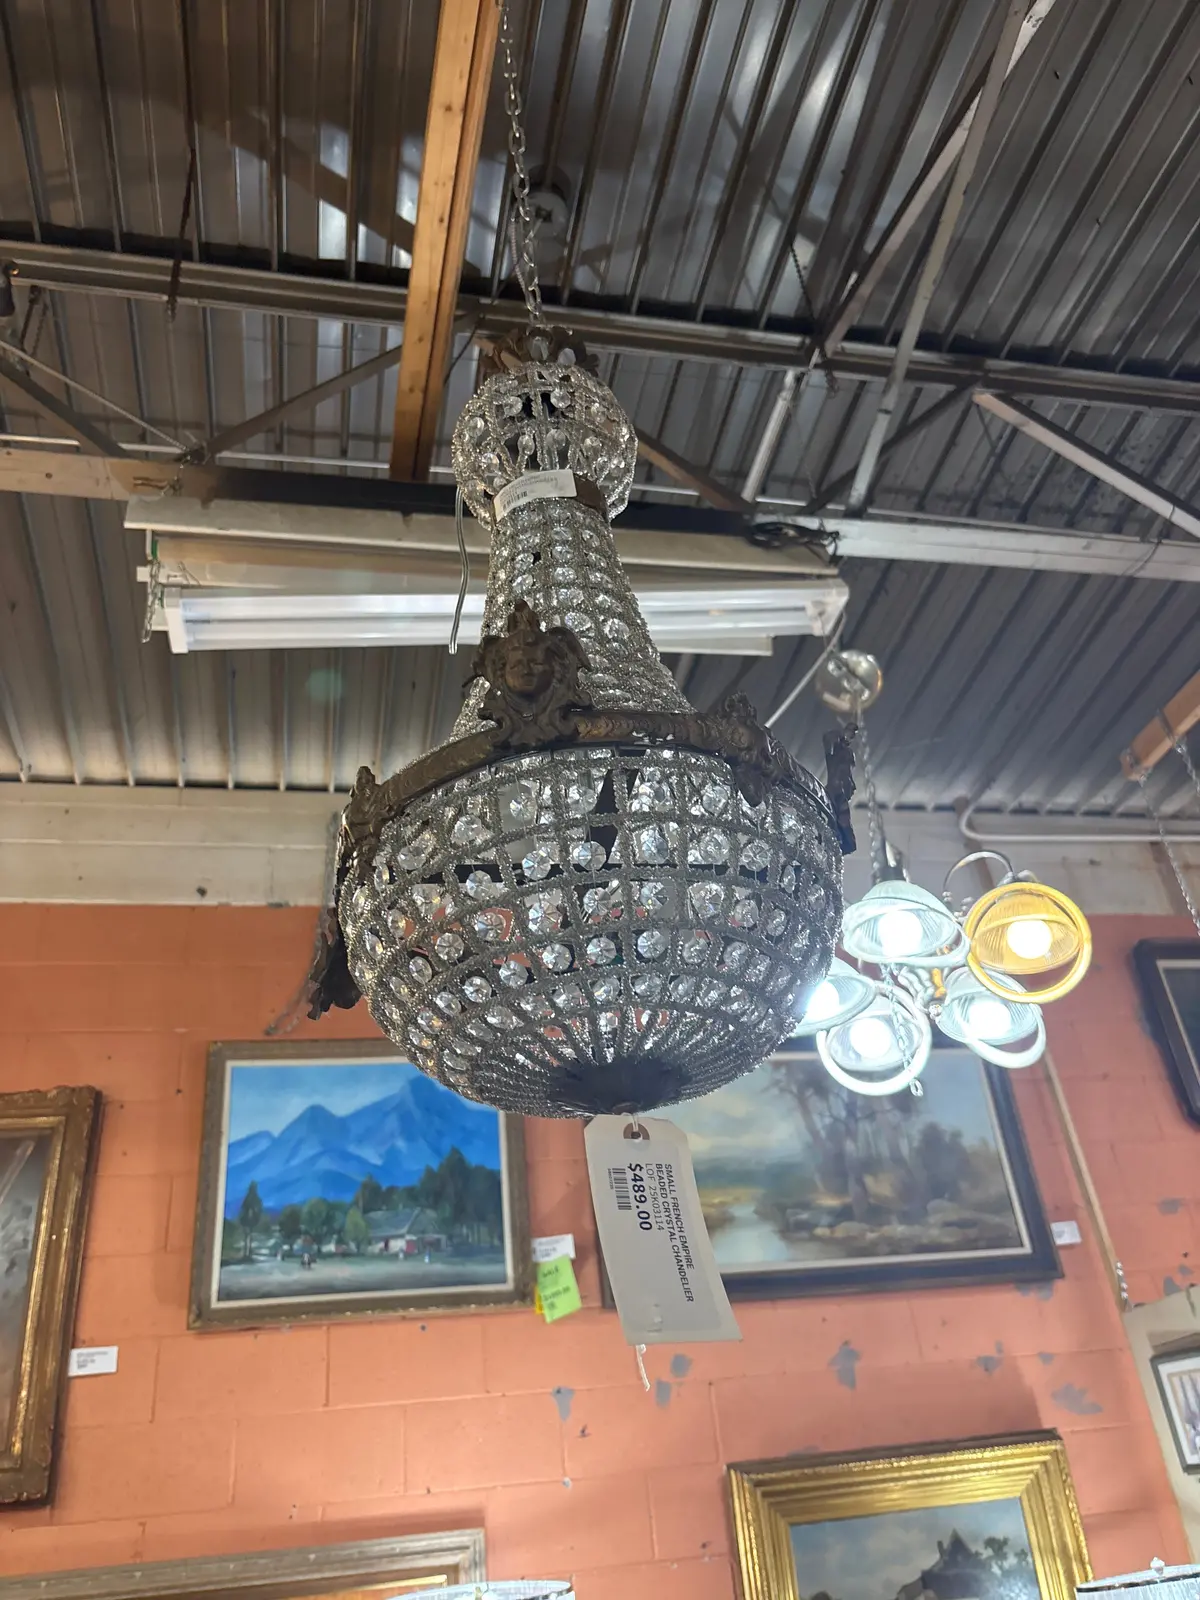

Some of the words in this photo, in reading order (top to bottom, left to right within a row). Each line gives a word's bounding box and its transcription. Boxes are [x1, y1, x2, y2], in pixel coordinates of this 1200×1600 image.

[628, 1163, 652, 1230] $489.00
[645, 1163, 655, 1183] LOF
[649, 1186, 664, 1230] 25K03114
[656, 1163, 668, 1199] BEADED
[662, 1201, 676, 1242] CRYSTAL
[672, 1245, 694, 1302] CHANDELIER
[665, 1163, 676, 1193] SMALL
[671, 1196, 682, 1233] FRENCH
[680, 1236, 694, 1269] EMPIRE
